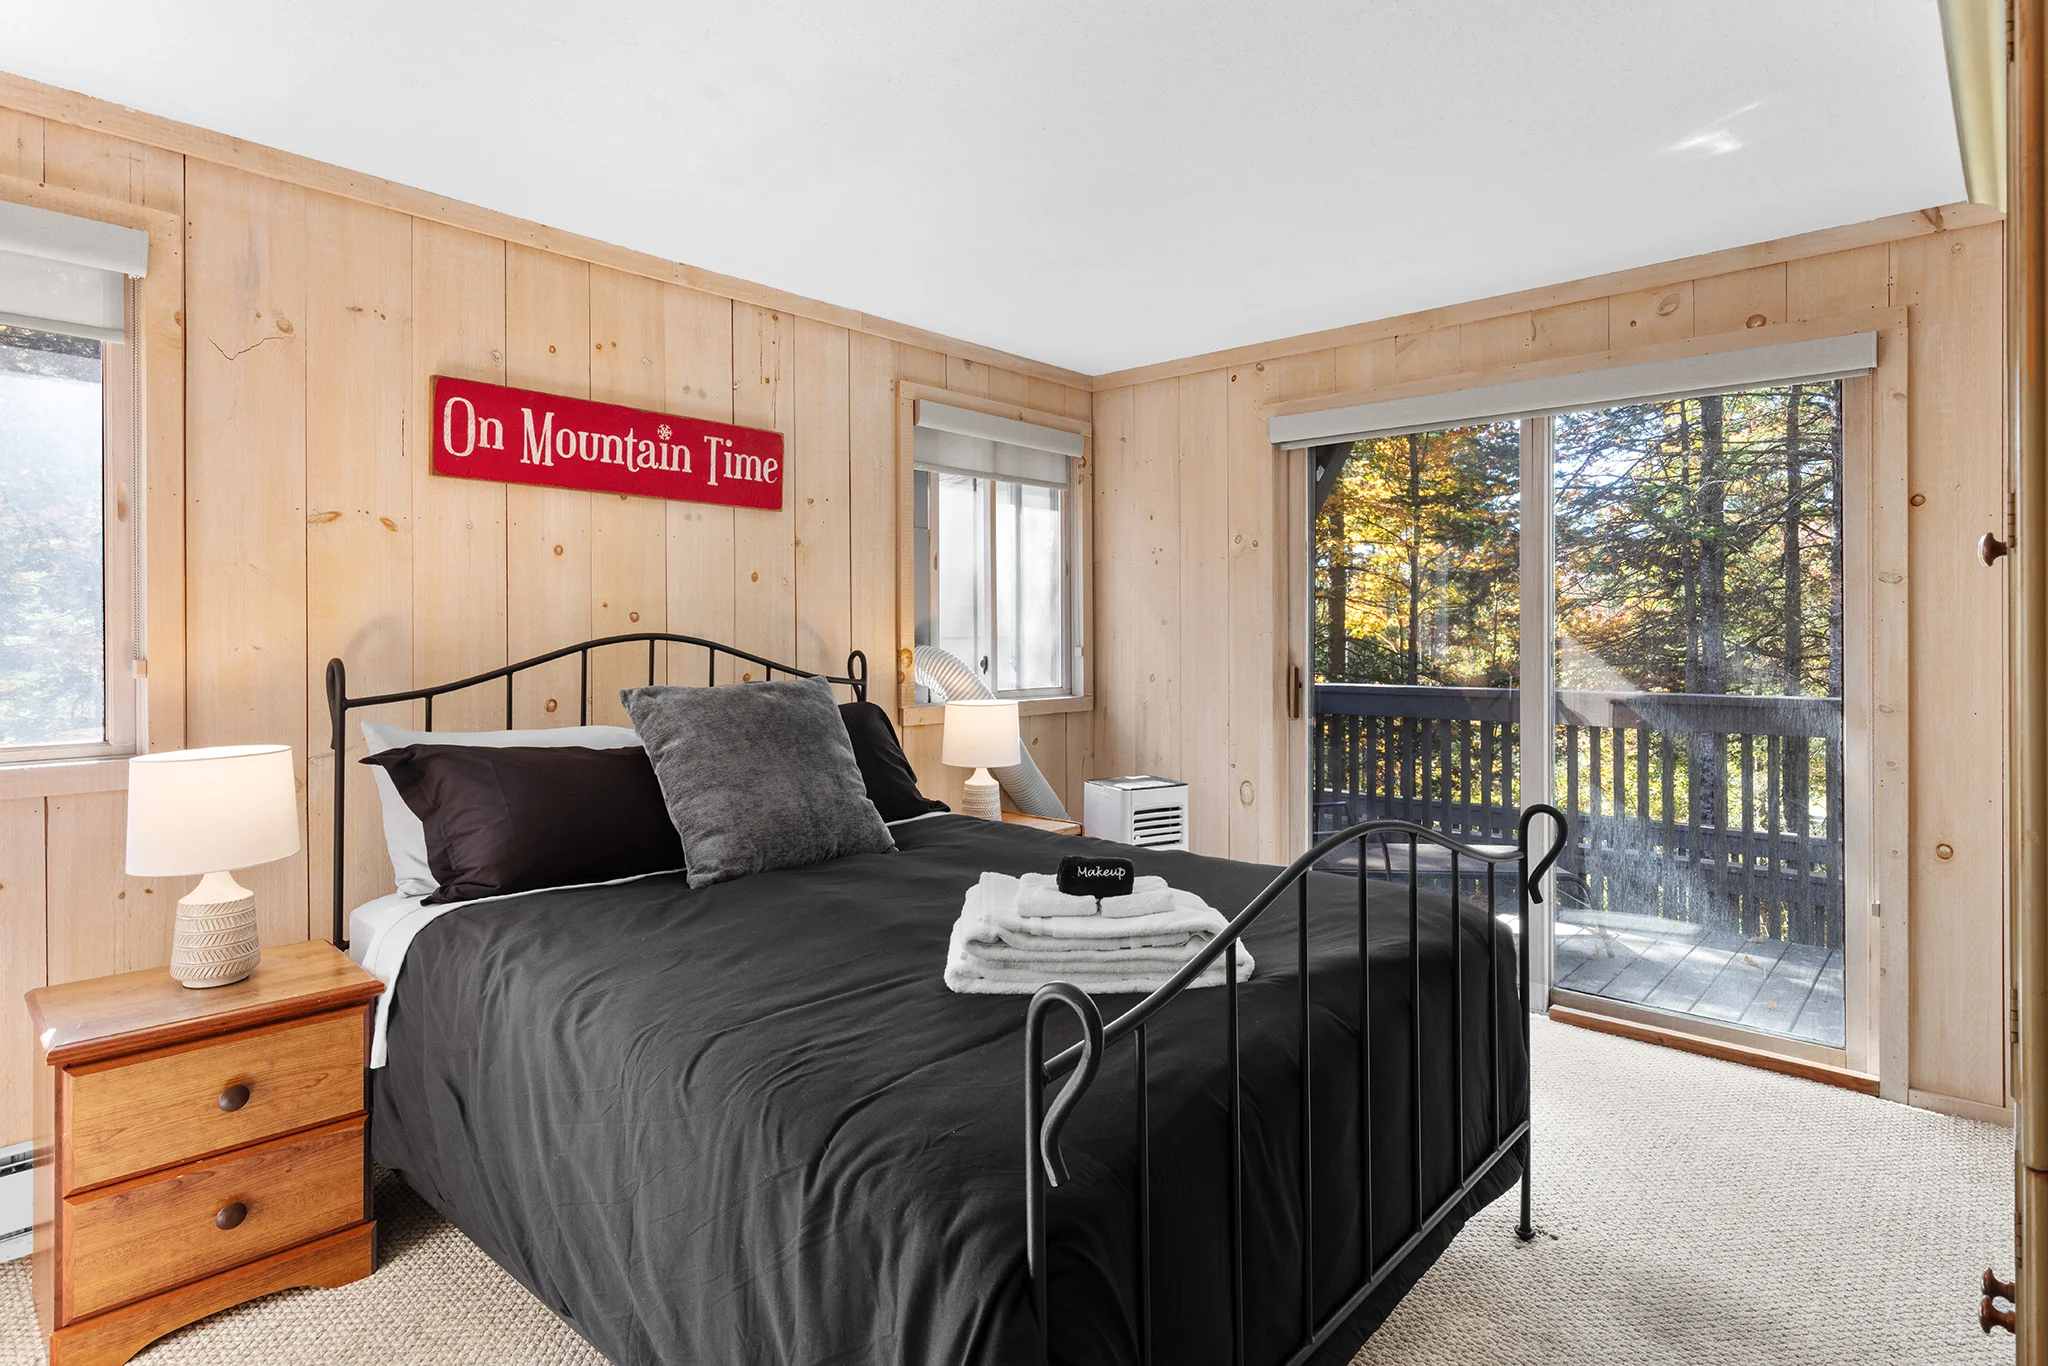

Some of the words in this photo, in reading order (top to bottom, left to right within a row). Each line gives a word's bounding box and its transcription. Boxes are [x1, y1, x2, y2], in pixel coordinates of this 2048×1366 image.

[443, 396, 505, 457] On
[520, 407, 692, 473] Mountain
[703, 435, 779, 486] Time
[1077, 865, 1126, 880] Makeup
